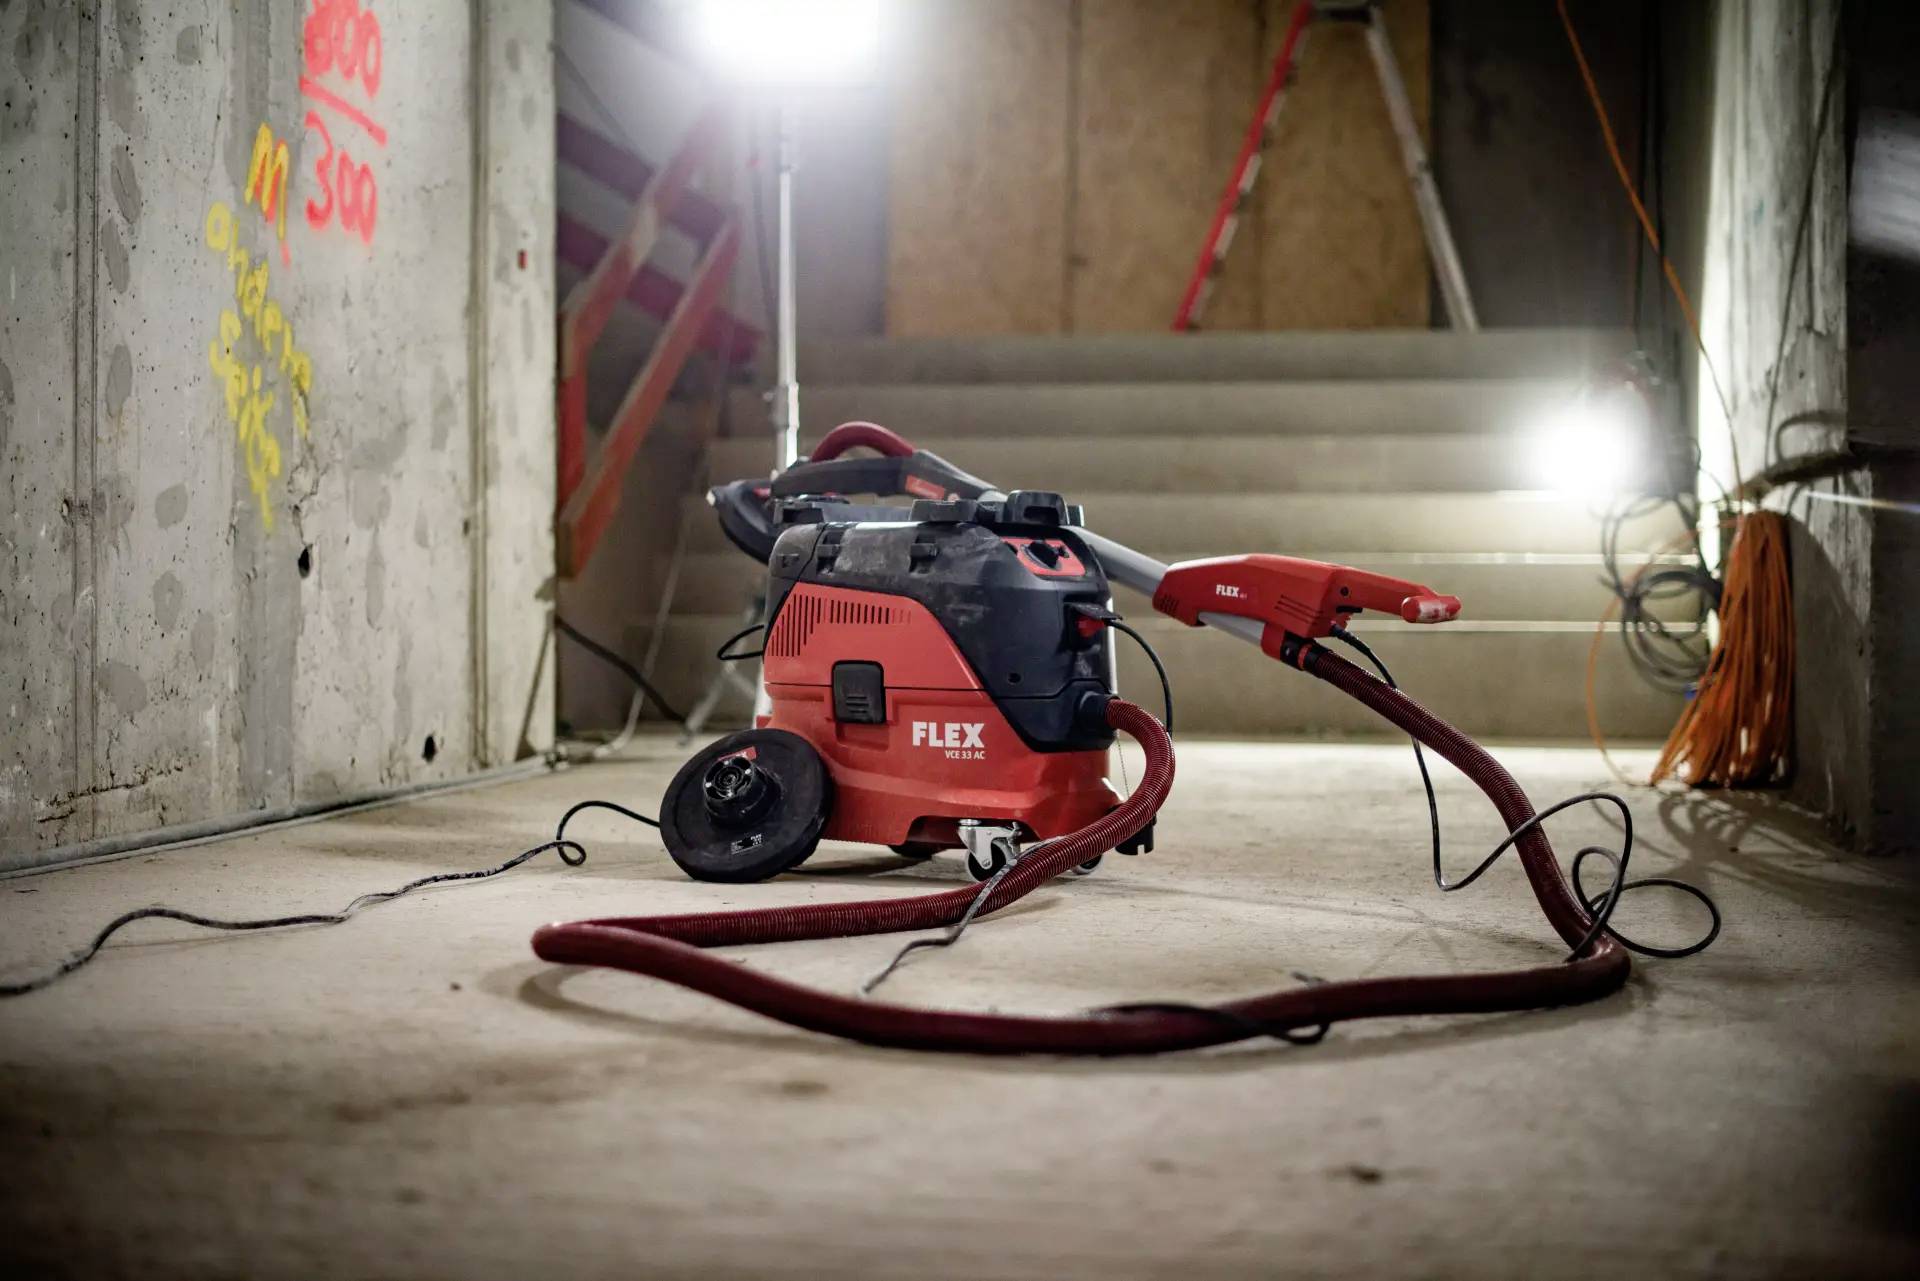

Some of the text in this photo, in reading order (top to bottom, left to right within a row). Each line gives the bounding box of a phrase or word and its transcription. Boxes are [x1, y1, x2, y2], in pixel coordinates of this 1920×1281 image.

[304, 109, 377, 245] 300
[1216, 584, 1239, 598] FLEX
[912, 721, 985, 748] FLEX
[945, 750, 985, 760] VCE 33 AC
